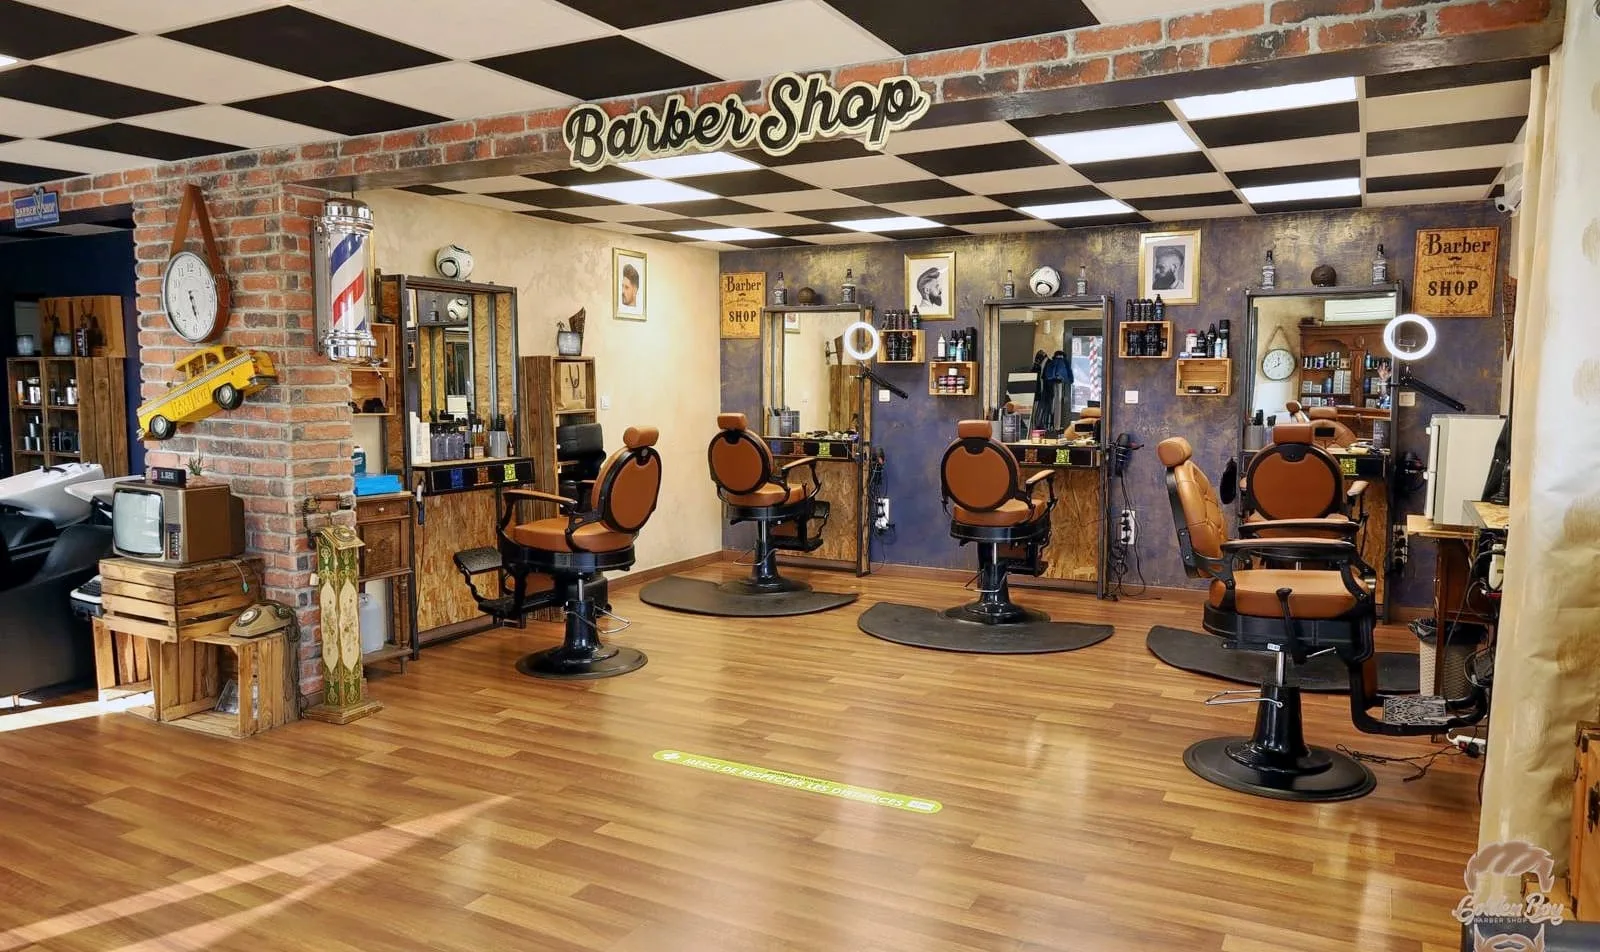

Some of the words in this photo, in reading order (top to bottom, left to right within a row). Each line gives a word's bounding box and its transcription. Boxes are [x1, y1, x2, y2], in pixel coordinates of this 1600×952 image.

[565, 97, 756, 167] Barber
[758, 74, 927, 150] Shop
[1422, 233, 1491, 256] Barber
[725, 276, 761, 292] Barber
[1428, 280, 1479, 296] SHOP
[729, 310, 757, 323] SHOP
[682, 758, 719, 771] MERCI
[720, 766, 738, 775] DE
